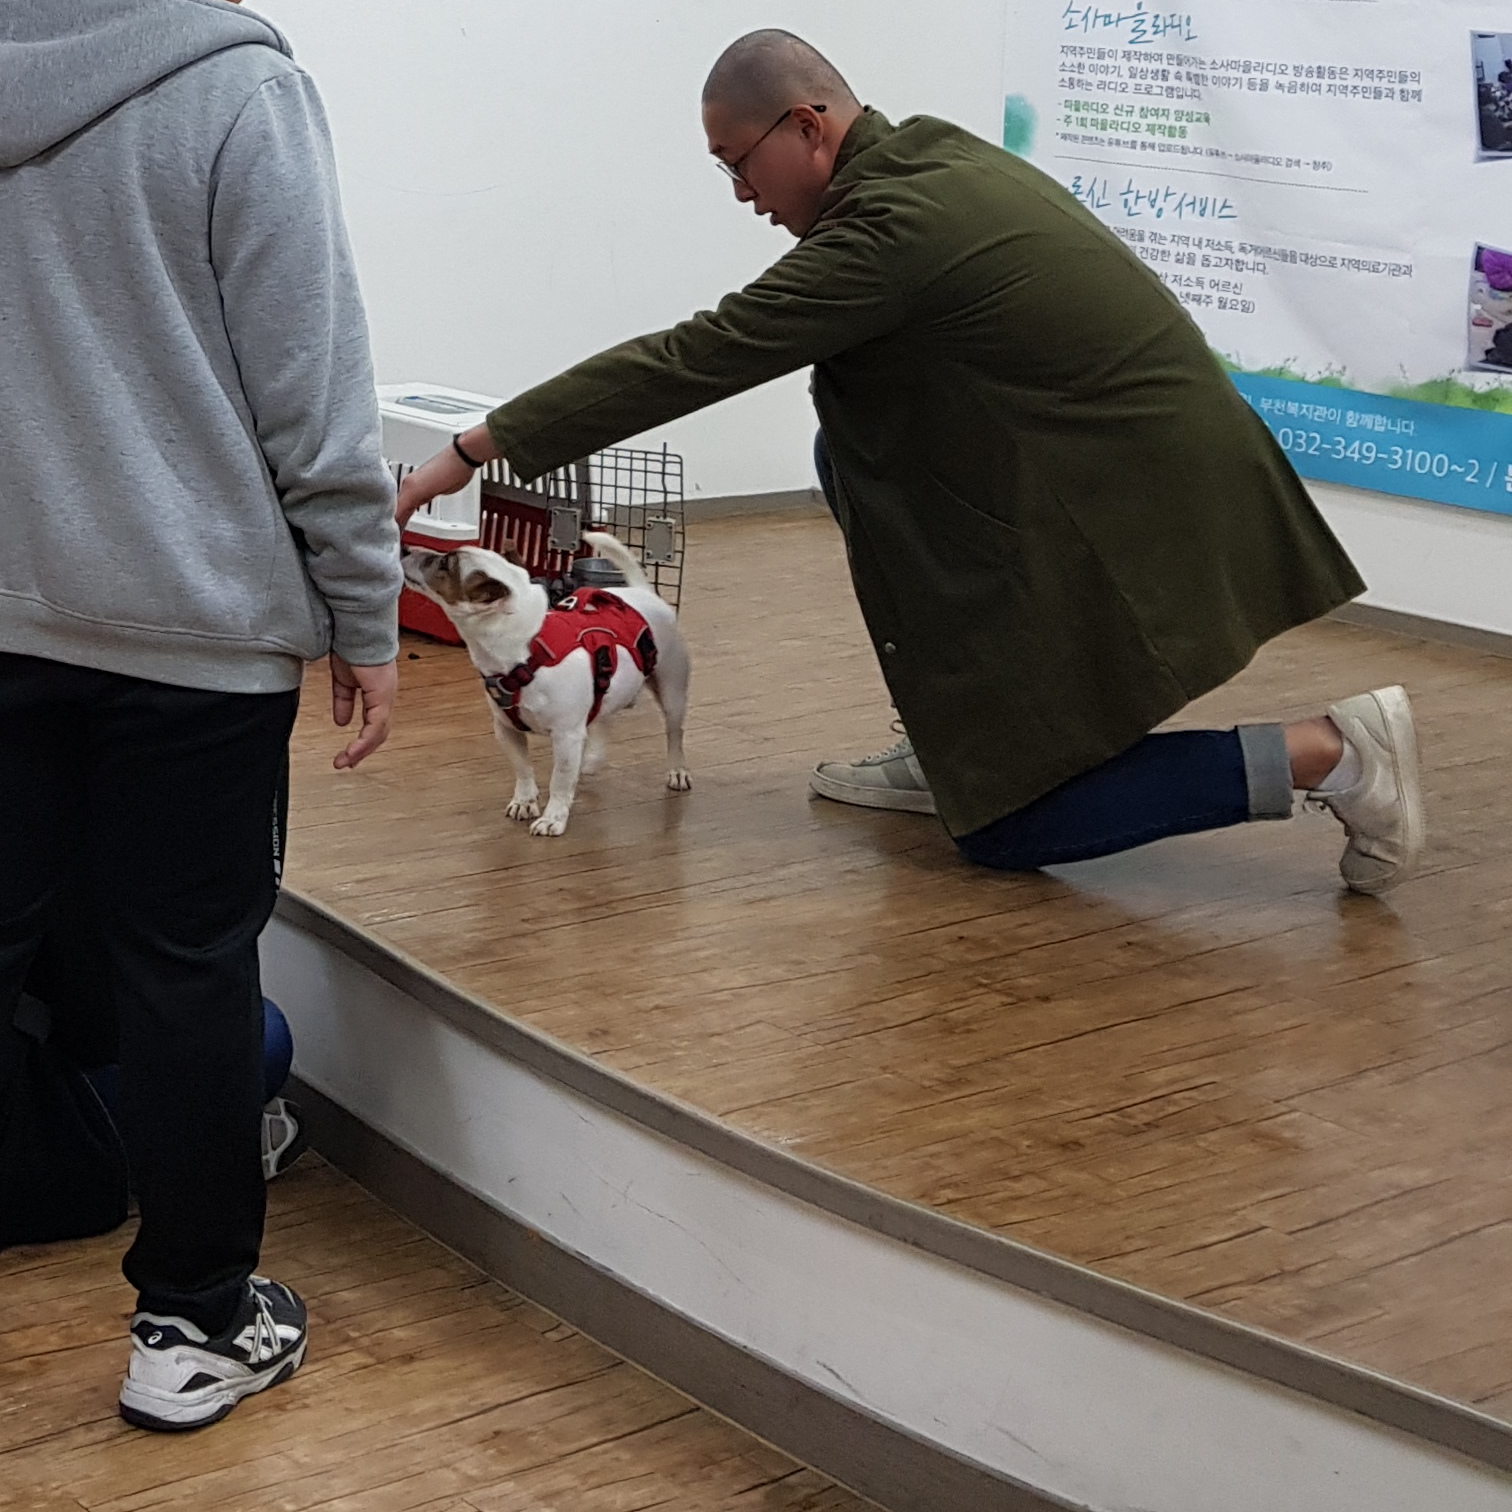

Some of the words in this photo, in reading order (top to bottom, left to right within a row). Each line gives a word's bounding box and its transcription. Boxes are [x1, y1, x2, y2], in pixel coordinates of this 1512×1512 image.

[1059, 45, 1117, 61] 지역주민들이
[1122, 49, 1163, 63] 제작하여
[1210, 58, 1288, 75] 소사마을라디오
[1293, 63, 1349, 81] 방송활동은
[1353, 68, 1421, 85] 지역주민들의
[1096, 80, 1129, 93] 라디오
[1128, 66, 1170, 81] 일상생활
[1212, 75, 1242, 90] 이야기
[1247, 77, 1270, 92] 등을
[1275, 80, 1322, 95] 녹음하여
[1326, 84, 1396, 100] 지역주민들과
[1399, 88, 1423, 102] 함께
[1113, 104, 1135, 117] 신규
[1139, 106, 1170, 120] 참여자
[1063, 114, 1073, 127] 주
[1145, 122, 1188, 139] 제작활동
[1066, 175, 1111, 208] 르신
[1139, 246, 1171, 262] 건강한
[1174, 251, 1196, 266] 삶을
[1148, 231, 1167, 246] 겪는
[1170, 234, 1190, 248] 지역
[1192, 236, 1202, 250] 내
[1299, 252, 1338, 269] 대상으로
[1340, 257, 1413, 278] 지역의료기관과
[1171, 274, 1205, 290] 저소득
[1209, 279, 1243, 295] 어르신
[1217, 296, 1255, 314] 월요일)
[1260, 397, 1341, 425] 부천복지관이
[1278, 427, 1481, 484] 032-349-3100~2
